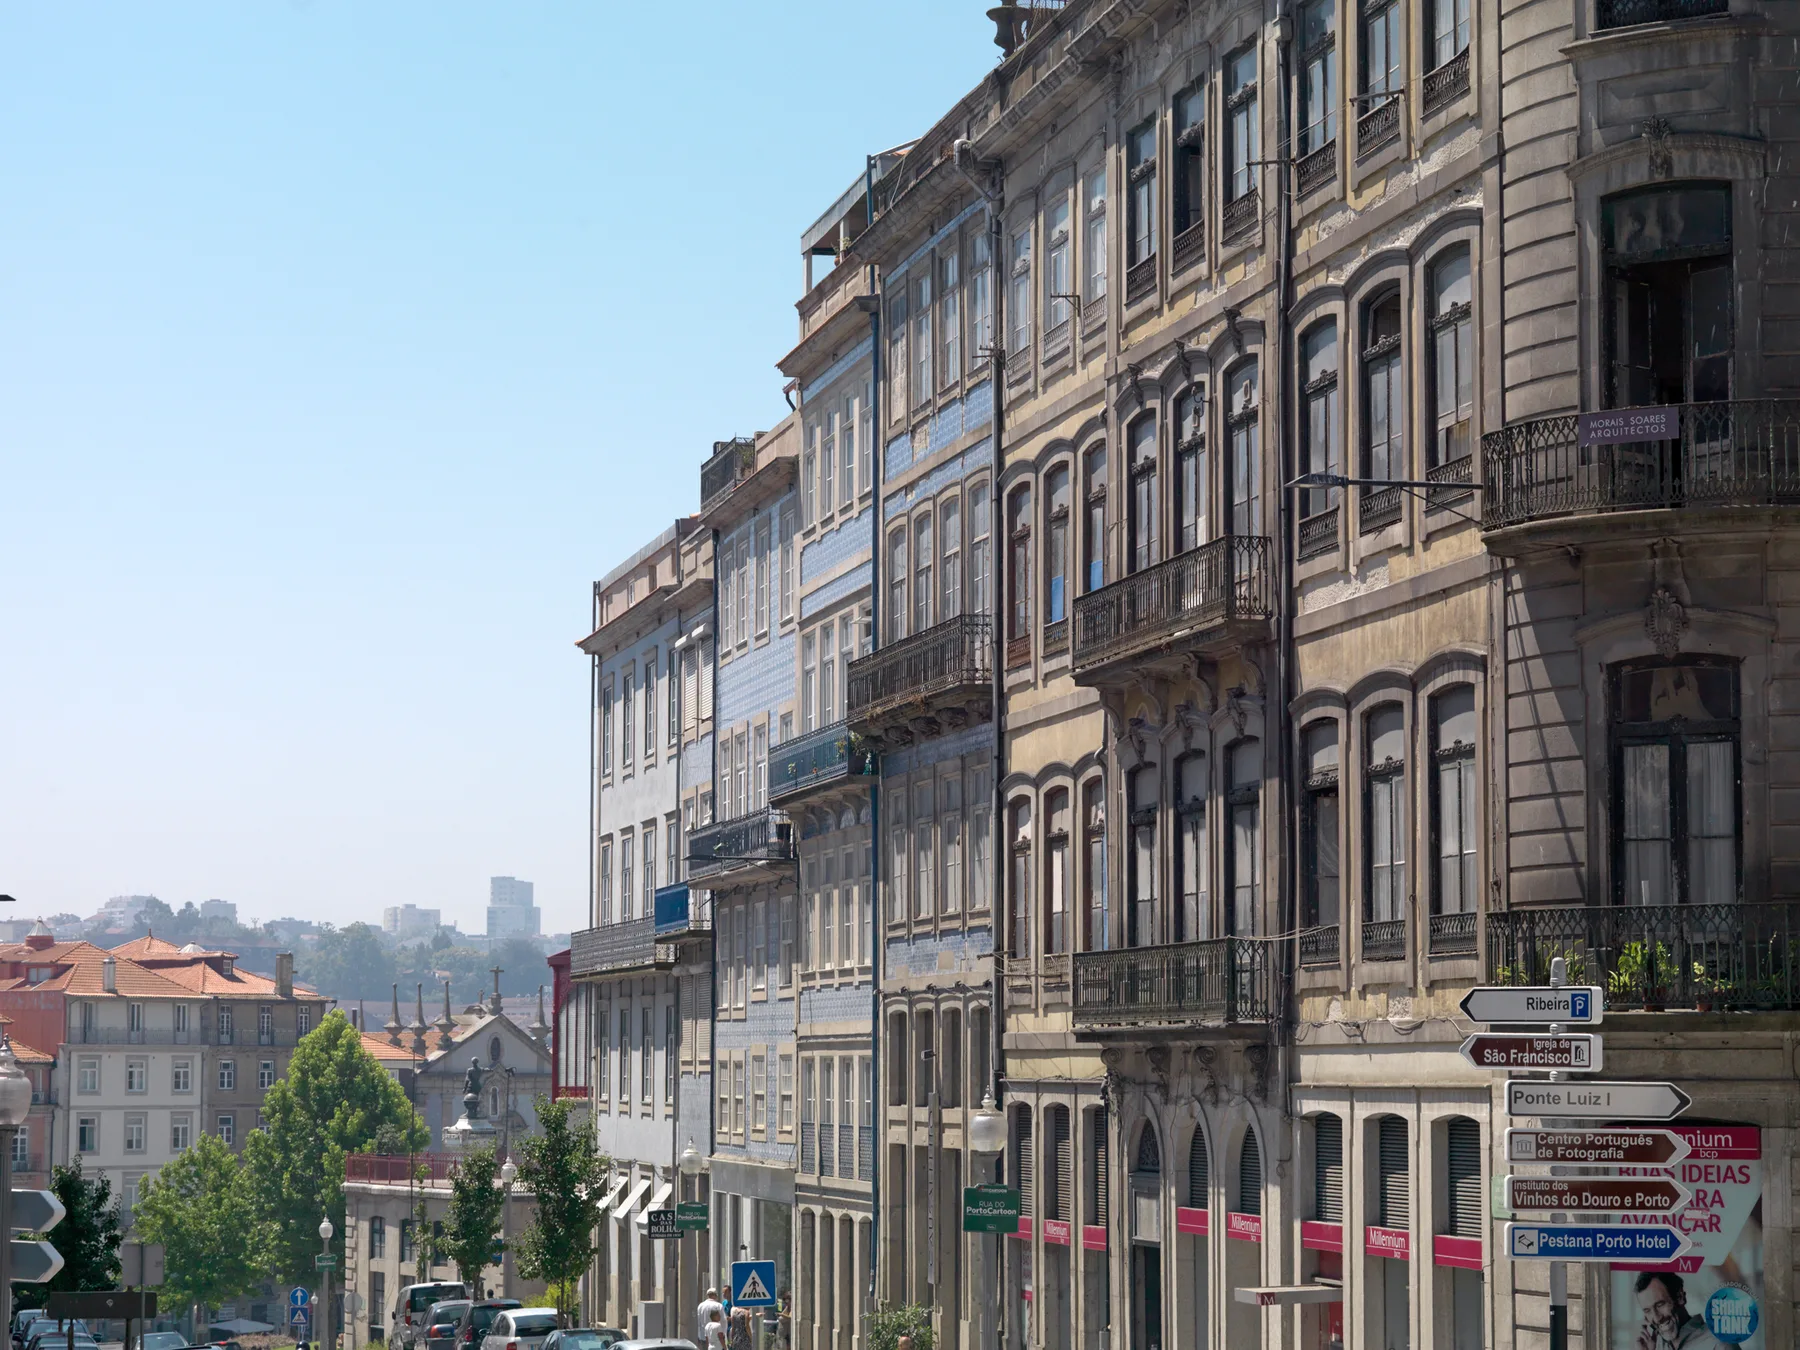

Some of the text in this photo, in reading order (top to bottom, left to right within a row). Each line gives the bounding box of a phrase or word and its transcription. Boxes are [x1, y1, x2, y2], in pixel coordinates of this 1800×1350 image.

[1590, 414, 1666, 429] MORAIS SOARES
[1590, 424, 1666, 439] ARQUITECTOS
[1526, 997, 1570, 1010] Ribeira
[1559, 1038, 1570, 1049] de
[1484, 1048, 1570, 1064] São Francisco
[1513, 1091, 1611, 1106] Ponte Luiz I
[1537, 1132, 1653, 1148] Centro Português
[1537, 1146, 1624, 1161] de Fotografia
[1699, 1149, 1718, 1159] bcp
[1681, 1164, 1751, 1184] IDEIAS
[1514, 1180, 1568, 1191] instituto dos
[979, 1200, 993, 1208] RUA
[1514, 1191, 1670, 1207] Vinhos do Douro e Porto
[651, 1212, 677, 1221] CAS
[966, 1206, 1017, 1215] PortoCartoon
[1231, 1214, 1261, 1233] Millennium
[1369, 1227, 1406, 1249] Millennium
[1539, 1232, 1670, 1249] Pestana Porto Hotel
[1712, 1299, 1750, 1315] SHARK
[1713, 1316, 1752, 1334] TANK
